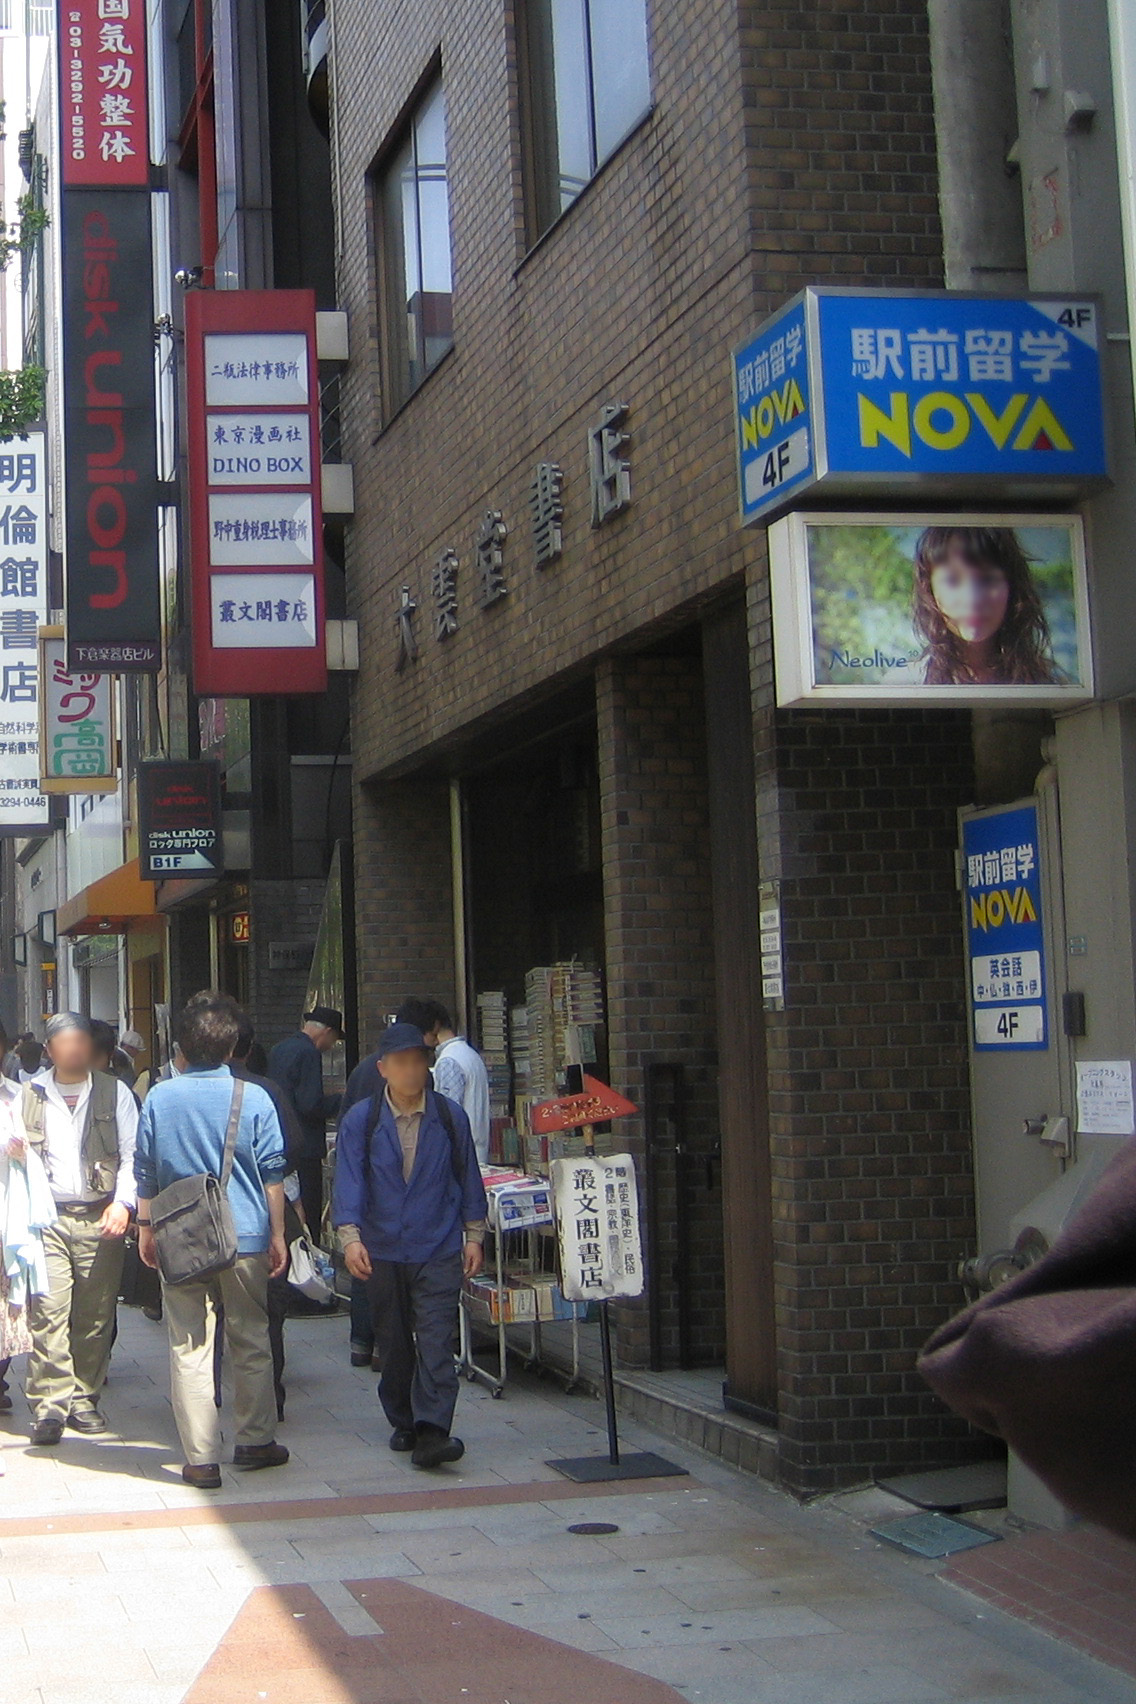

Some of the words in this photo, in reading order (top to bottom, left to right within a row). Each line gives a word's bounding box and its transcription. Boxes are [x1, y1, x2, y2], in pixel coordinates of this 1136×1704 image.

[97, 0, 136, 163] 国気功整体
[82, 210, 119, 340] disk
[1057, 309, 1091, 329] 4F
[738, 324, 802, 403] 駅前留学
[851, 327, 1071, 383] 駅前留学
[741, 378, 805, 450] NOVA
[858, 391, 1075, 458] NOVA
[214, 425, 302, 445] 東京漫画社
[84, 351, 137, 608] union
[213, 458, 261, 473] DINO
[267, 457, 304, 472] BOX
[763, 441, 790, 487] 4F
[76, 647, 154, 661] 下倉楽器店ビル
[829, 648, 908, 670] Neolive
[0, 797, 46, 807] 3294-0446
[149, 839, 215, 849] ロック専門フロア
[172, 828, 215, 838] union
[153, 857, 181, 868] B1F
[968, 843, 1035, 887] 駅前留学
[971, 887, 1037, 933] NOVA
[989, 956, 1022, 979] 英会話
[996, 1011, 1019, 1038] 4F
[572, 1168, 603, 1288] 叢文閣書店
